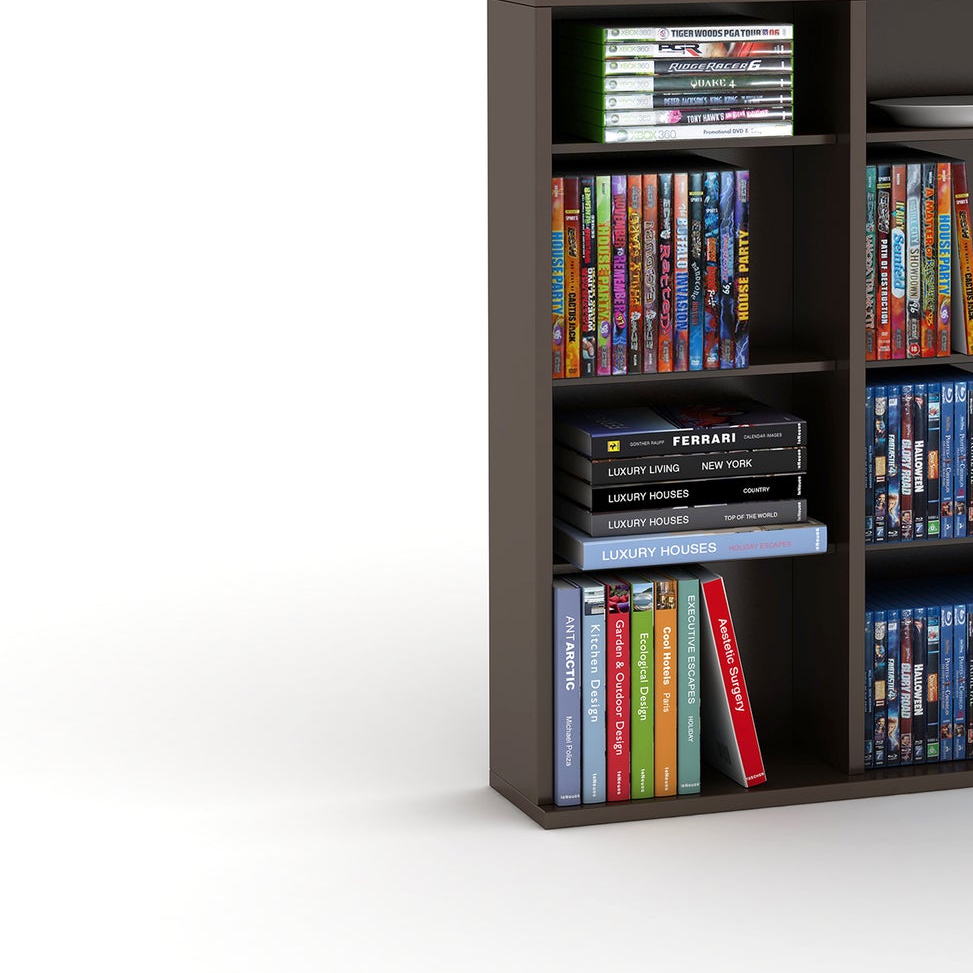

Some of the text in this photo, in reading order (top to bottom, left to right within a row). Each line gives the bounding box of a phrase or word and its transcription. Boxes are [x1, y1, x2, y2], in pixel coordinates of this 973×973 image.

[691, 80, 736, 88] QUAKE 4
[925, 187, 934, 245] A MATTER
[552, 231, 563, 315] HOUSE PARTY
[598, 226, 609, 319] HOUSE PARTY
[614, 194, 626, 312] NOVEMBER REMEMBER
[676, 218, 688, 331] BUFFALO INVASION
[738, 230, 748, 321] HOUSE PARTY
[881, 261, 887, 269] OF
[910, 248, 919, 298] SHOWDOWN
[939, 215, 950, 295] HOUSE PARTY
[568, 293, 576, 321] CACTUS
[722, 282, 732, 295] '99
[965, 273, 973, 300] CACTUS
[673, 433, 736, 446] FERRARI
[608, 459, 752, 477] LUXURY LIVING NEW YORK
[902, 439, 911, 495] GLORY ROAD
[915, 440, 924, 493] HALLOWEEN
[608, 492, 646, 503] LUXURY
[650, 490, 689, 500] HOUSES
[608, 519, 646, 530] LUXURY
[650, 516, 689, 527] HOUSES
[602, 541, 791, 561] LUXURY HOUSES HOLIDAY ESCAPES
[565, 616, 575, 691] ANTARCTIC
[591, 625, 600, 673] Kitchen
[616, 620, 625, 658] Garden
[637, 633, 649, 684] Ecological
[663, 627, 671, 652] Cool
[663, 655, 671, 685] Hotels
[718, 618, 734, 664] Aestetic
[729, 667, 745, 712] Surgery
[588, 679, 600, 723] Design
[616, 672, 625, 718] Outdoor
[637, 687, 649, 721] Design
[914, 664, 923, 715] HALLOWEEN
[613, 721, 625, 755] Design
